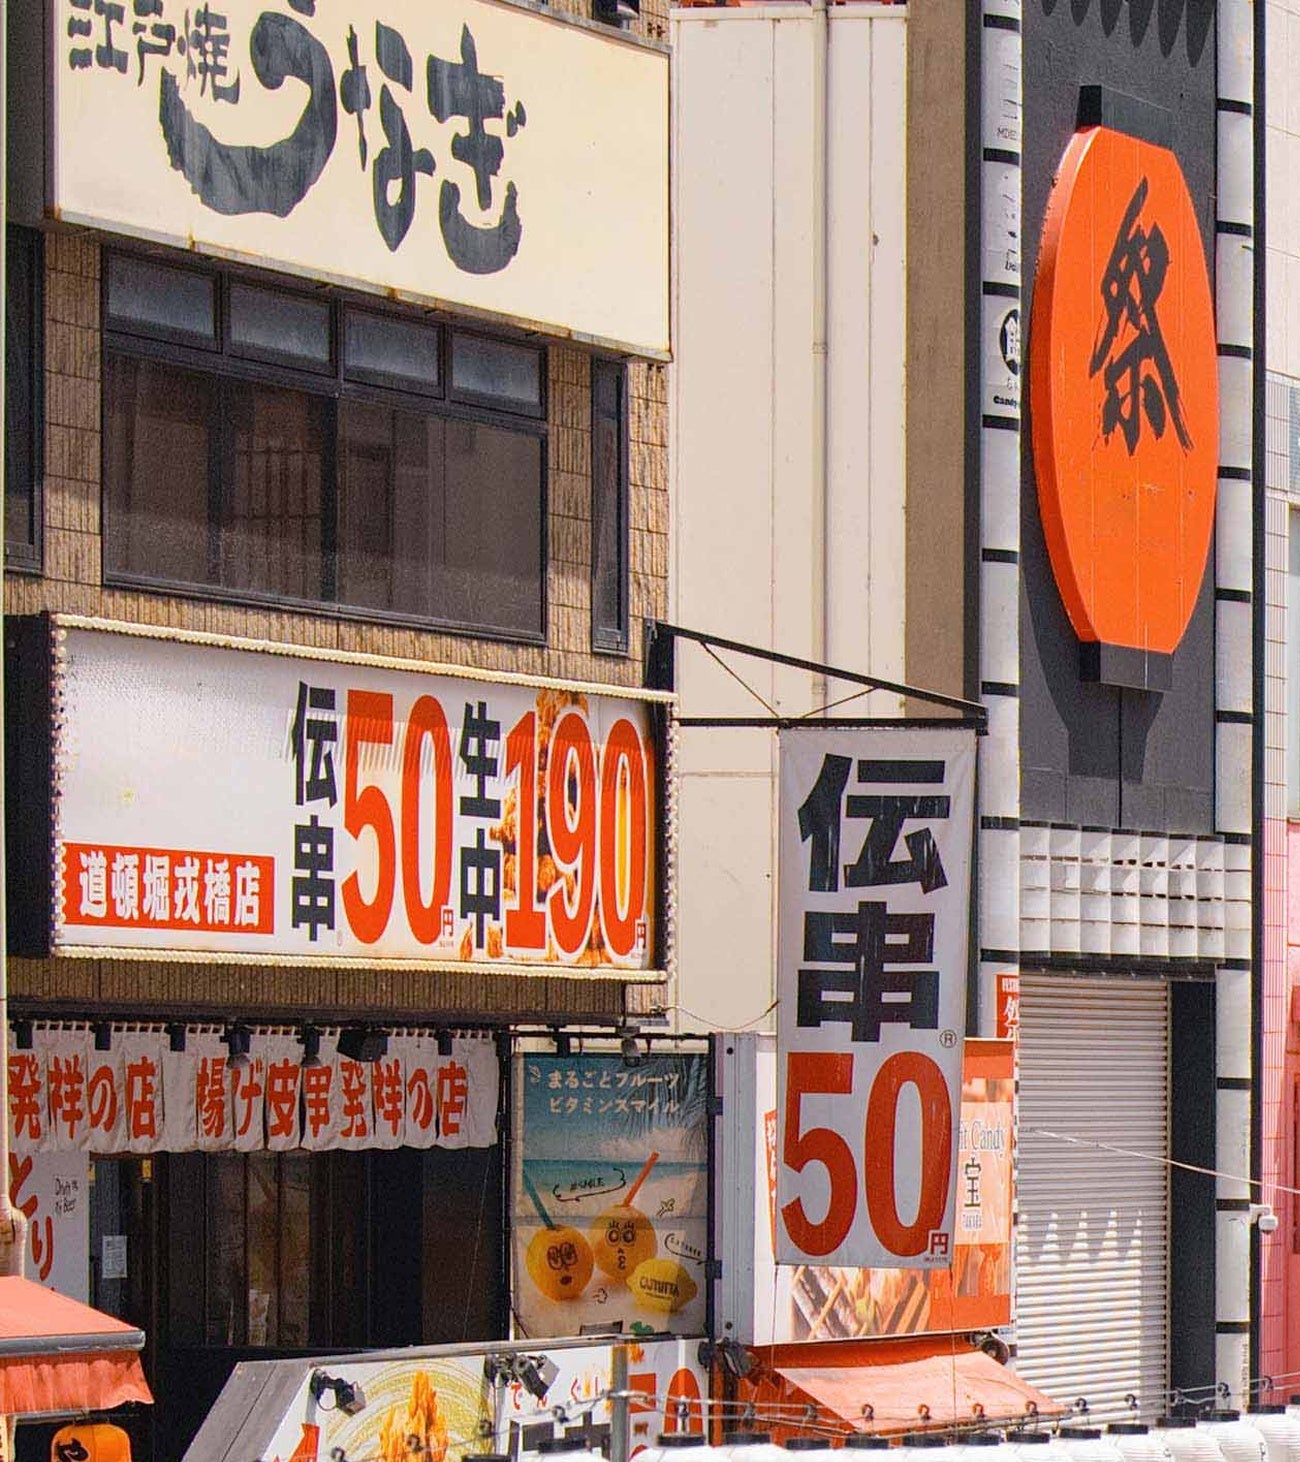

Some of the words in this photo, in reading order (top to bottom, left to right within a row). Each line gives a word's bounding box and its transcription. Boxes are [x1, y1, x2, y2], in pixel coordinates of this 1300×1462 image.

[158, 0, 528, 276] うなぎ
[79, 851, 260, 927] 道頓堀戎橋店
[291, 681, 337, 942] 伝串
[340, 690, 454, 945] 50
[459, 701, 501, 949] 生中
[797, 753, 950, 1042] 伝串
[547, 1069, 681, 1089] まるごとフルーツ
[550, 1098, 681, 1114] ビタミンスマイル
[781, 1051, 952, 1257] 50
